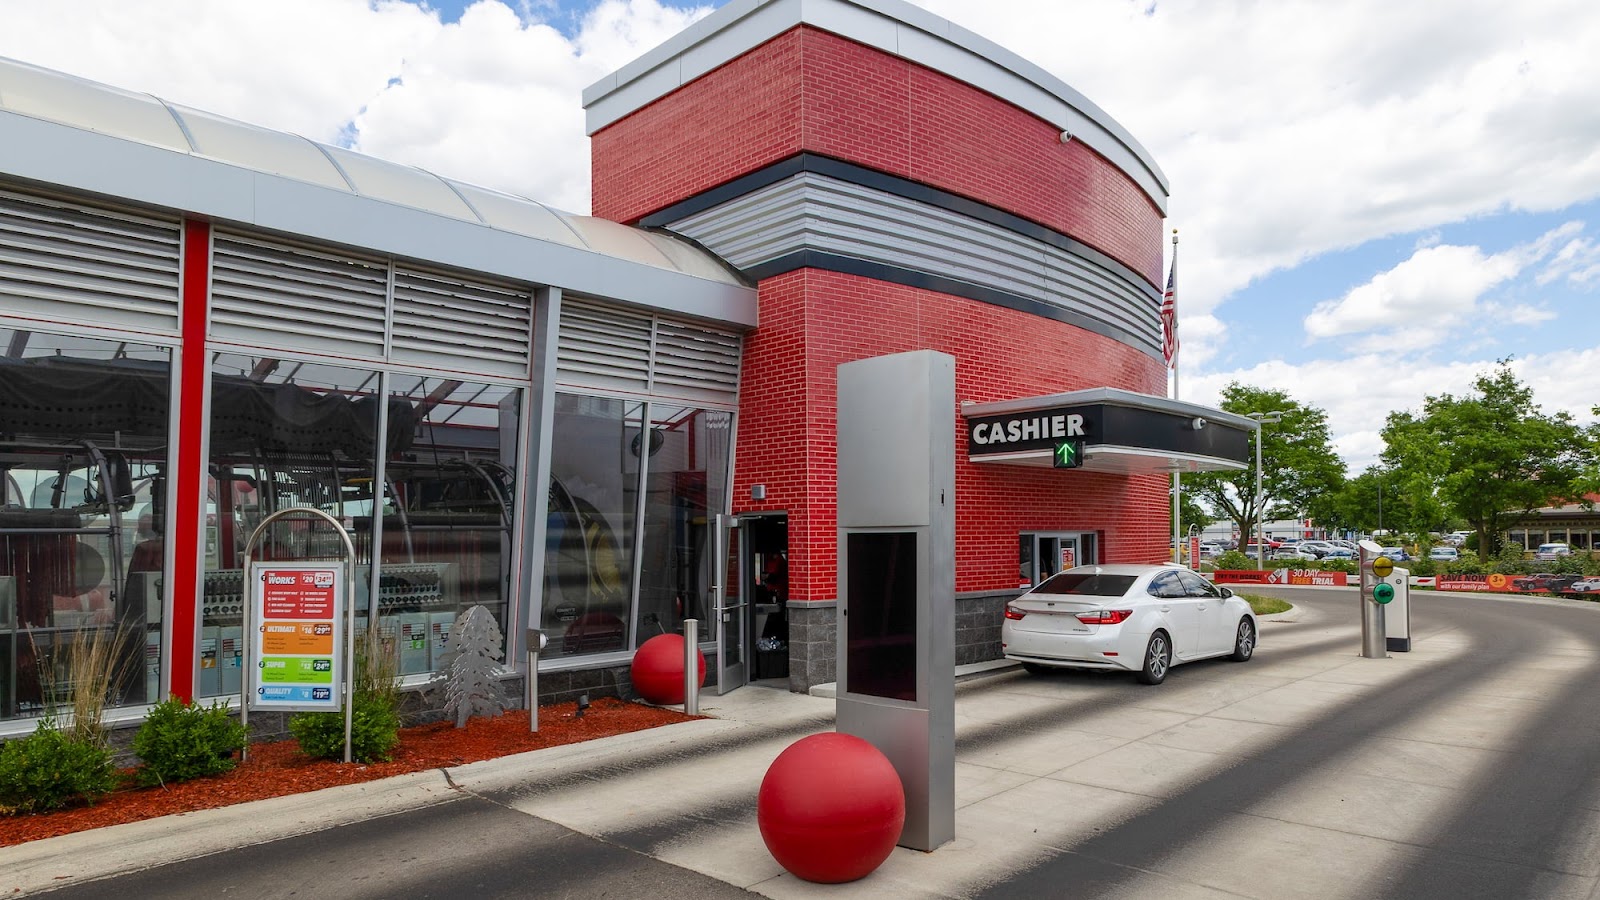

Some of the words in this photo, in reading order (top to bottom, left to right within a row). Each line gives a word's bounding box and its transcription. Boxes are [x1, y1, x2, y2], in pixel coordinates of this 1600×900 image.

[972, 414, 1085, 444] CASHIER
[1292, 568, 1302, 577] 30
[1304, 568, 1320, 577] DAY
[268, 576, 296, 584] WORKS
